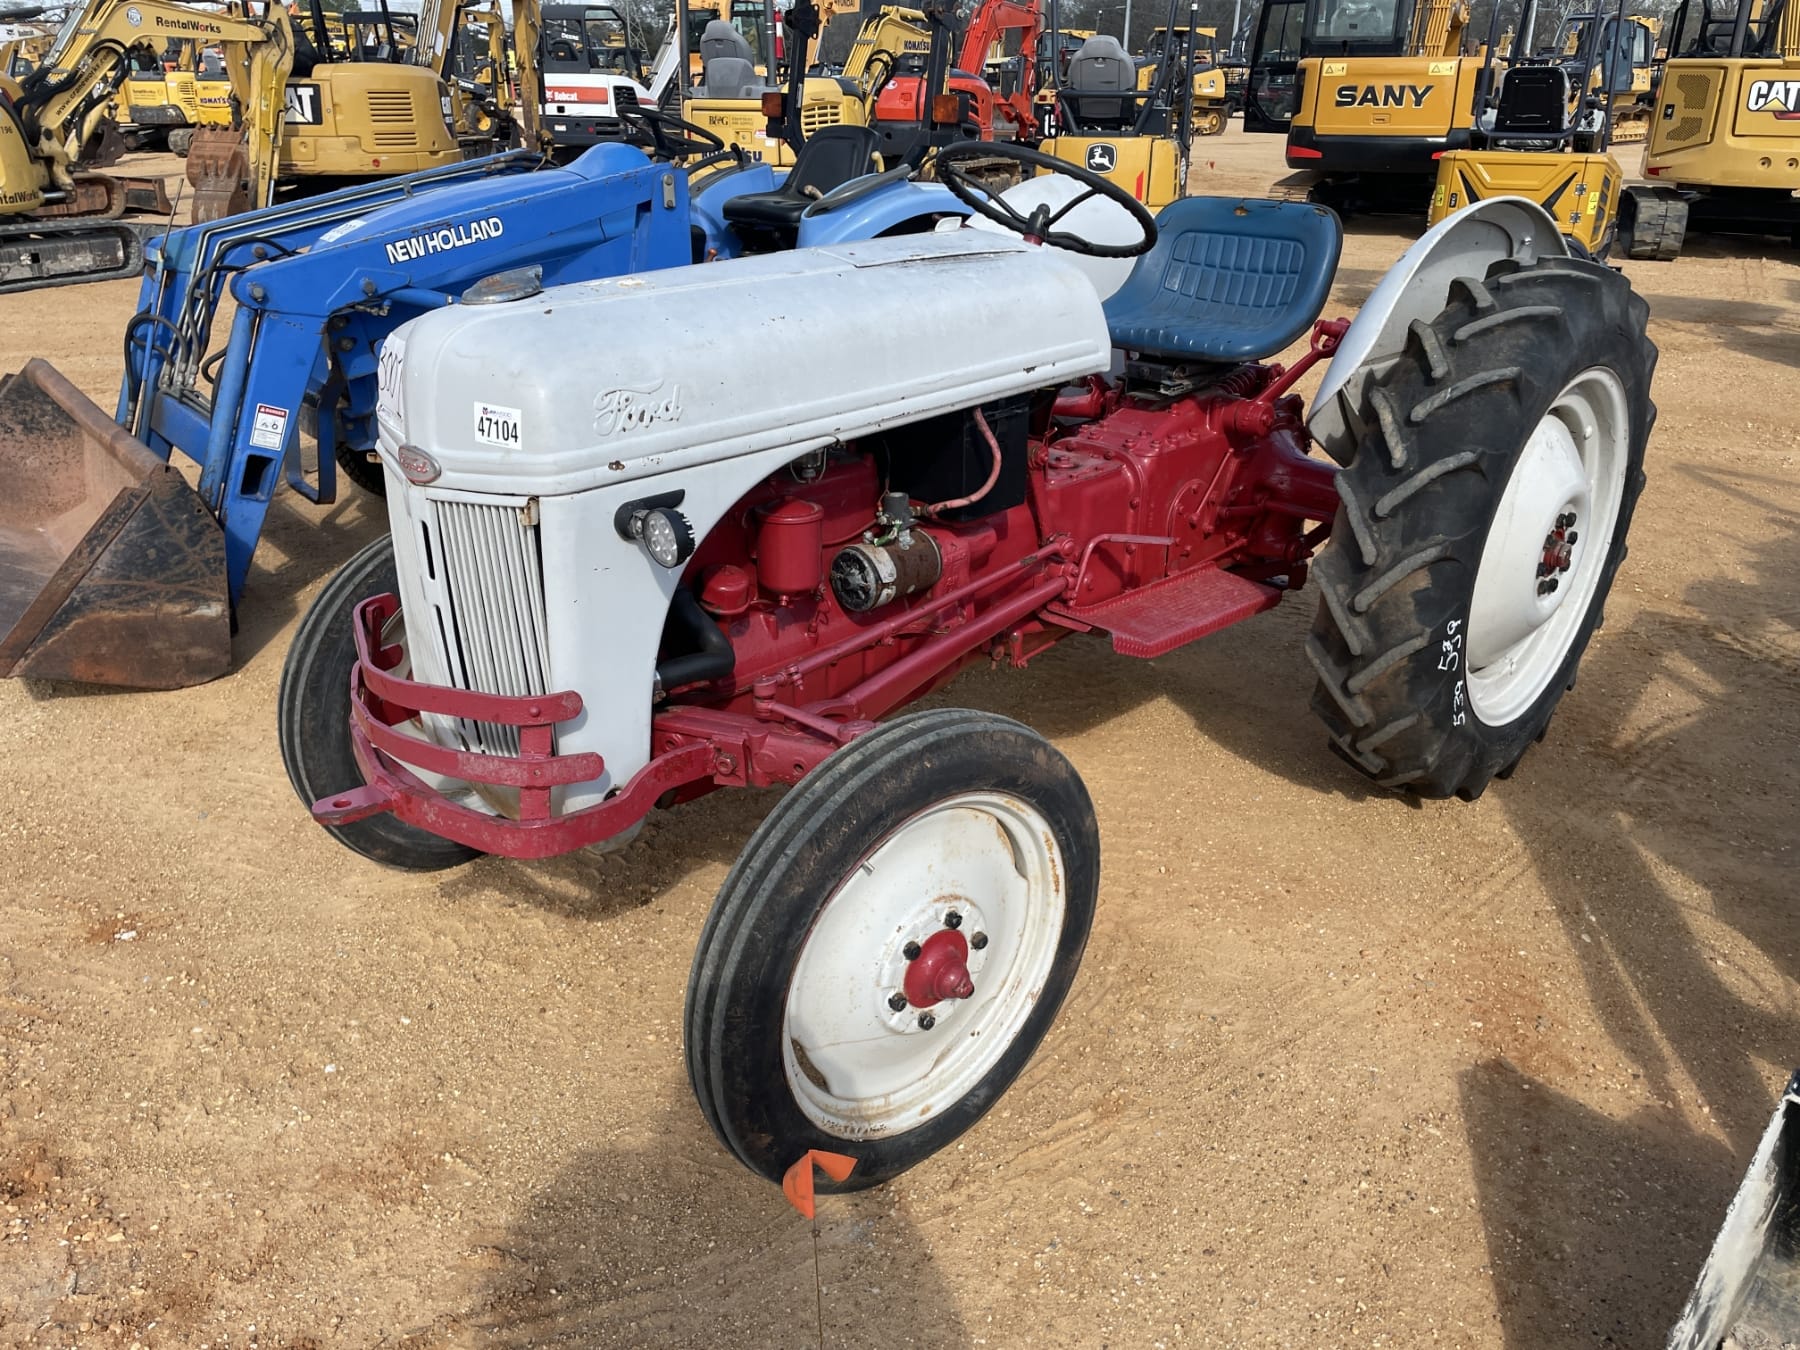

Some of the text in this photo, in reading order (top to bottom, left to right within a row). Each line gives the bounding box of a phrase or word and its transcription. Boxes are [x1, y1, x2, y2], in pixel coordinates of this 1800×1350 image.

[155, 15, 222, 34] RentalWorks
[285, 87, 315, 122] AT
[1334, 84, 1434, 108] SANY
[1747, 80, 1800, 111] CAT
[385, 217, 504, 264] NEW HOLLAND
[592, 378, 684, 438] Ford
[477, 415, 519, 443] 47104
